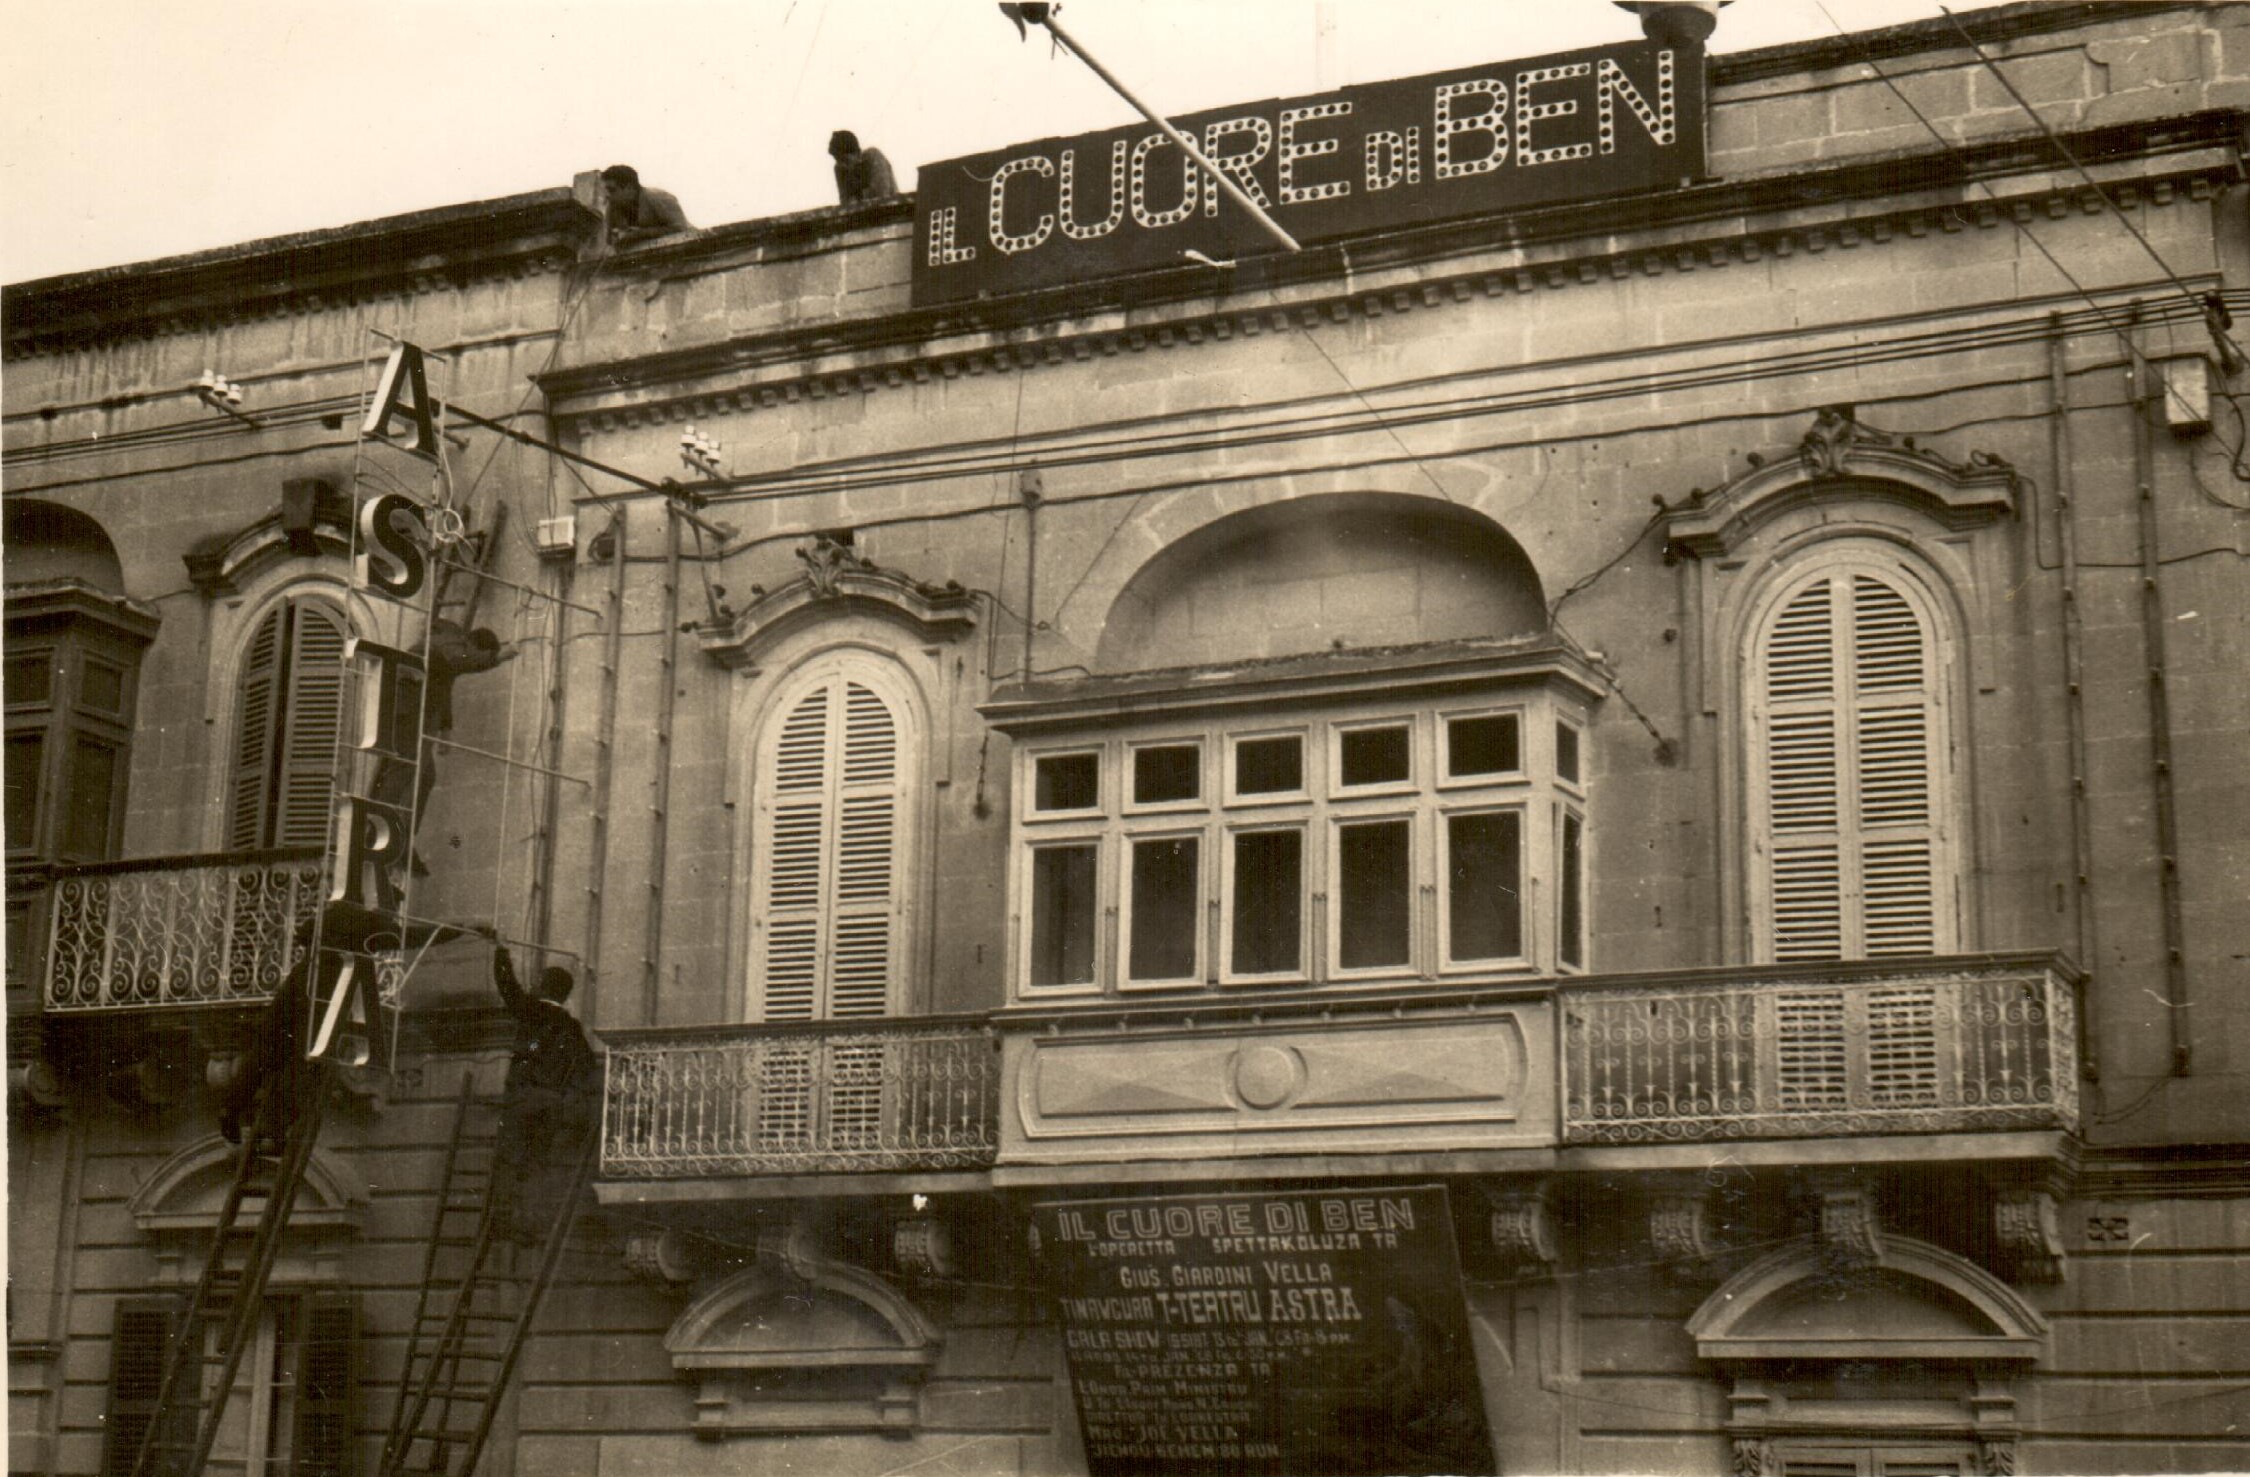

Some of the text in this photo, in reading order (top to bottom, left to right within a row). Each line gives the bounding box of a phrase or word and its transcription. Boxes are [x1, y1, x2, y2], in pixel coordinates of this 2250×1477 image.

[928, 49, 1677, 266] IL CUORE DI BEN
[309, 340, 440, 1067] ASTRA
[1057, 1199, 1416, 1241] IL CUORE DI BEN
[1172, 1263, 1253, 1287] GIARDINI
[1263, 1261, 1333, 1284] VELLA
[1269, 1287, 1362, 1323] ASTRA
